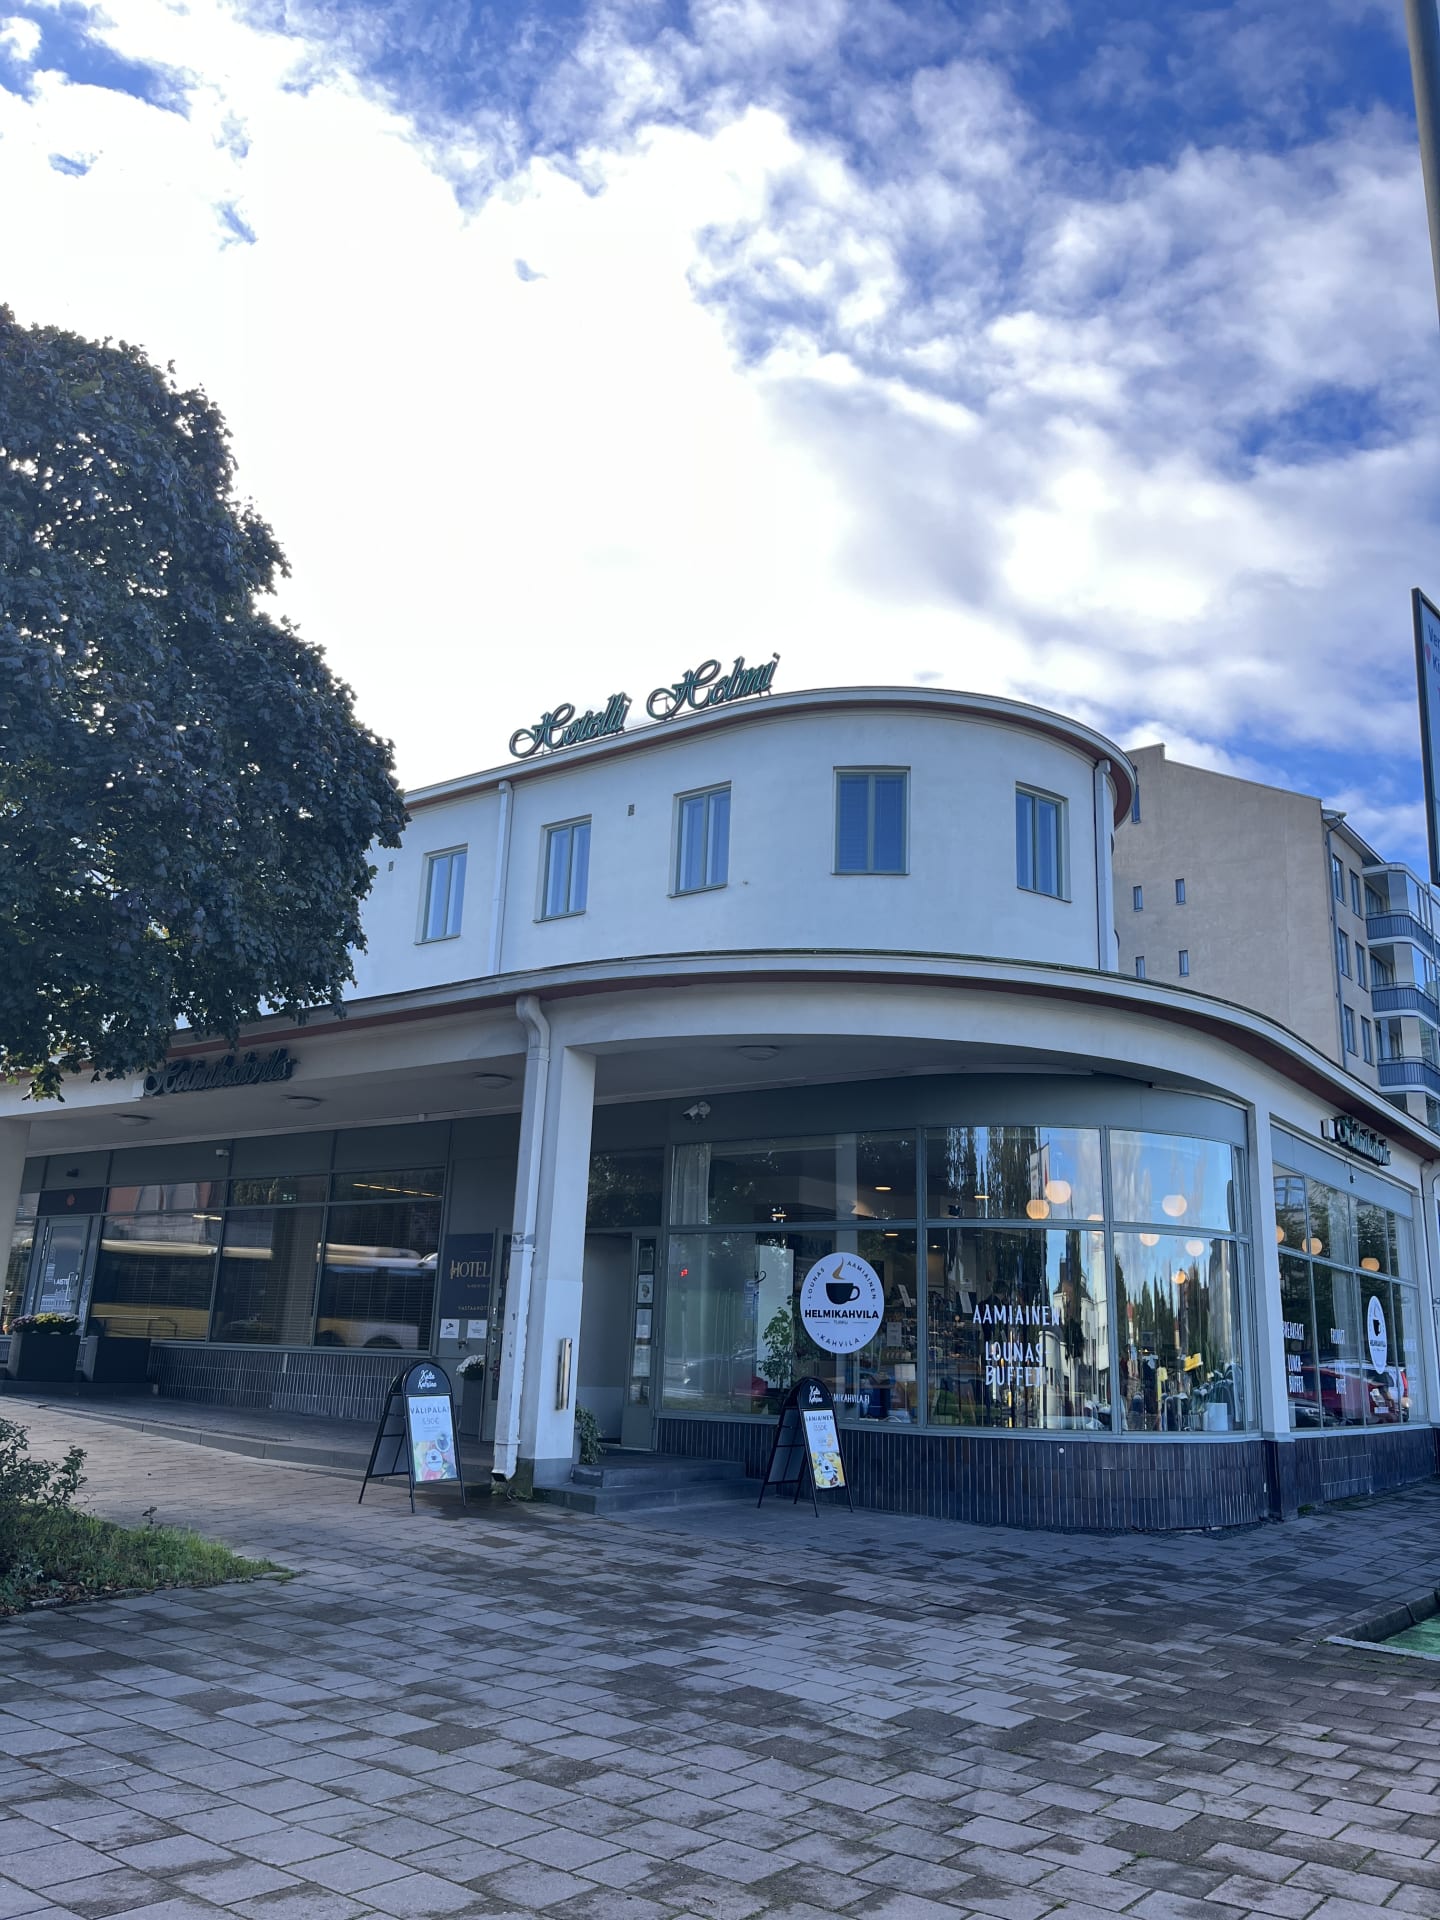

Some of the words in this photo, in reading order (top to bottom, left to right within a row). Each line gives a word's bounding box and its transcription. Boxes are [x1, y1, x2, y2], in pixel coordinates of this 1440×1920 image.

[508, 691, 633, 758] Hotelli
[646, 652, 780, 721] Helmi
[450, 1260, 490, 1280] HOTEL
[847, 1261, 877, 1300] AAMIAINEN
[807, 1267, 825, 1300] LOUNAS
[804, 1309, 879, 1319] HELMIKAHVILA
[973, 1304, 1060, 1326] AAMIAINEN
[820, 1333, 860, 1347] KAHVILA
[985, 1365, 1042, 1387] BUFFET
